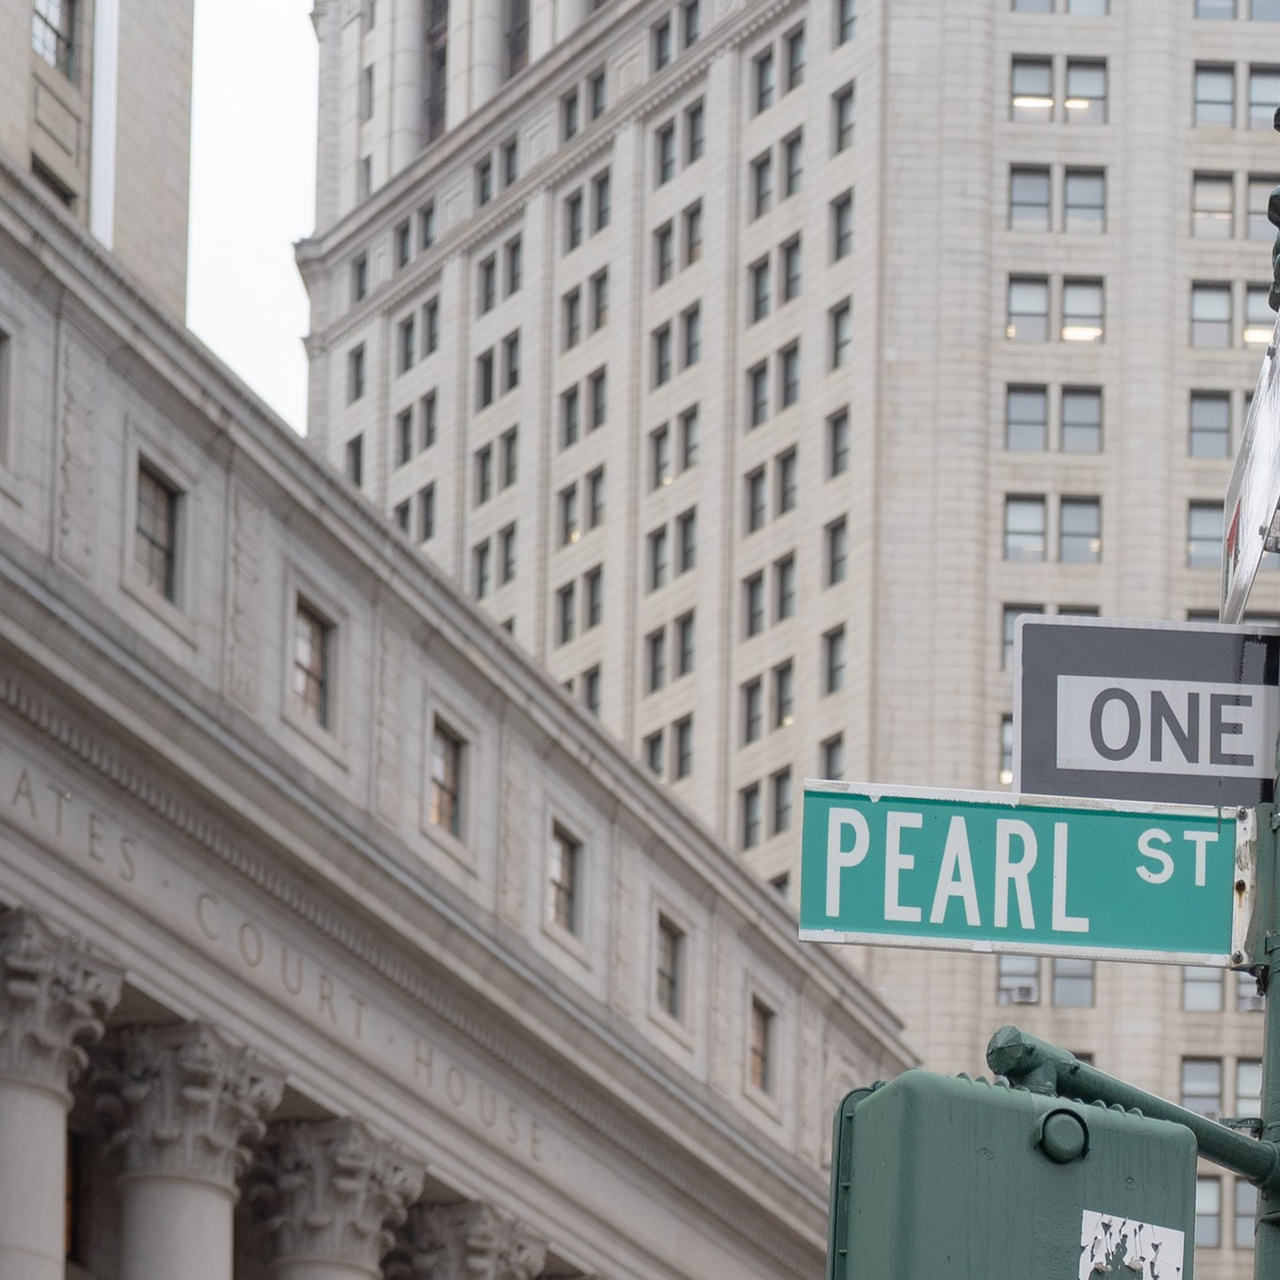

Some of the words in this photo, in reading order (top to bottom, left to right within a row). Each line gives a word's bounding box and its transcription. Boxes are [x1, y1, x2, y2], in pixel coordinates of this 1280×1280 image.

[1090, 687, 1254, 767] ONE
[826, 807, 1090, 933] PEARL
[1135, 828, 1219, 887] ST
[196, 891, 368, 1039] COURT
[413, 1037, 542, 1162] HOUSE
